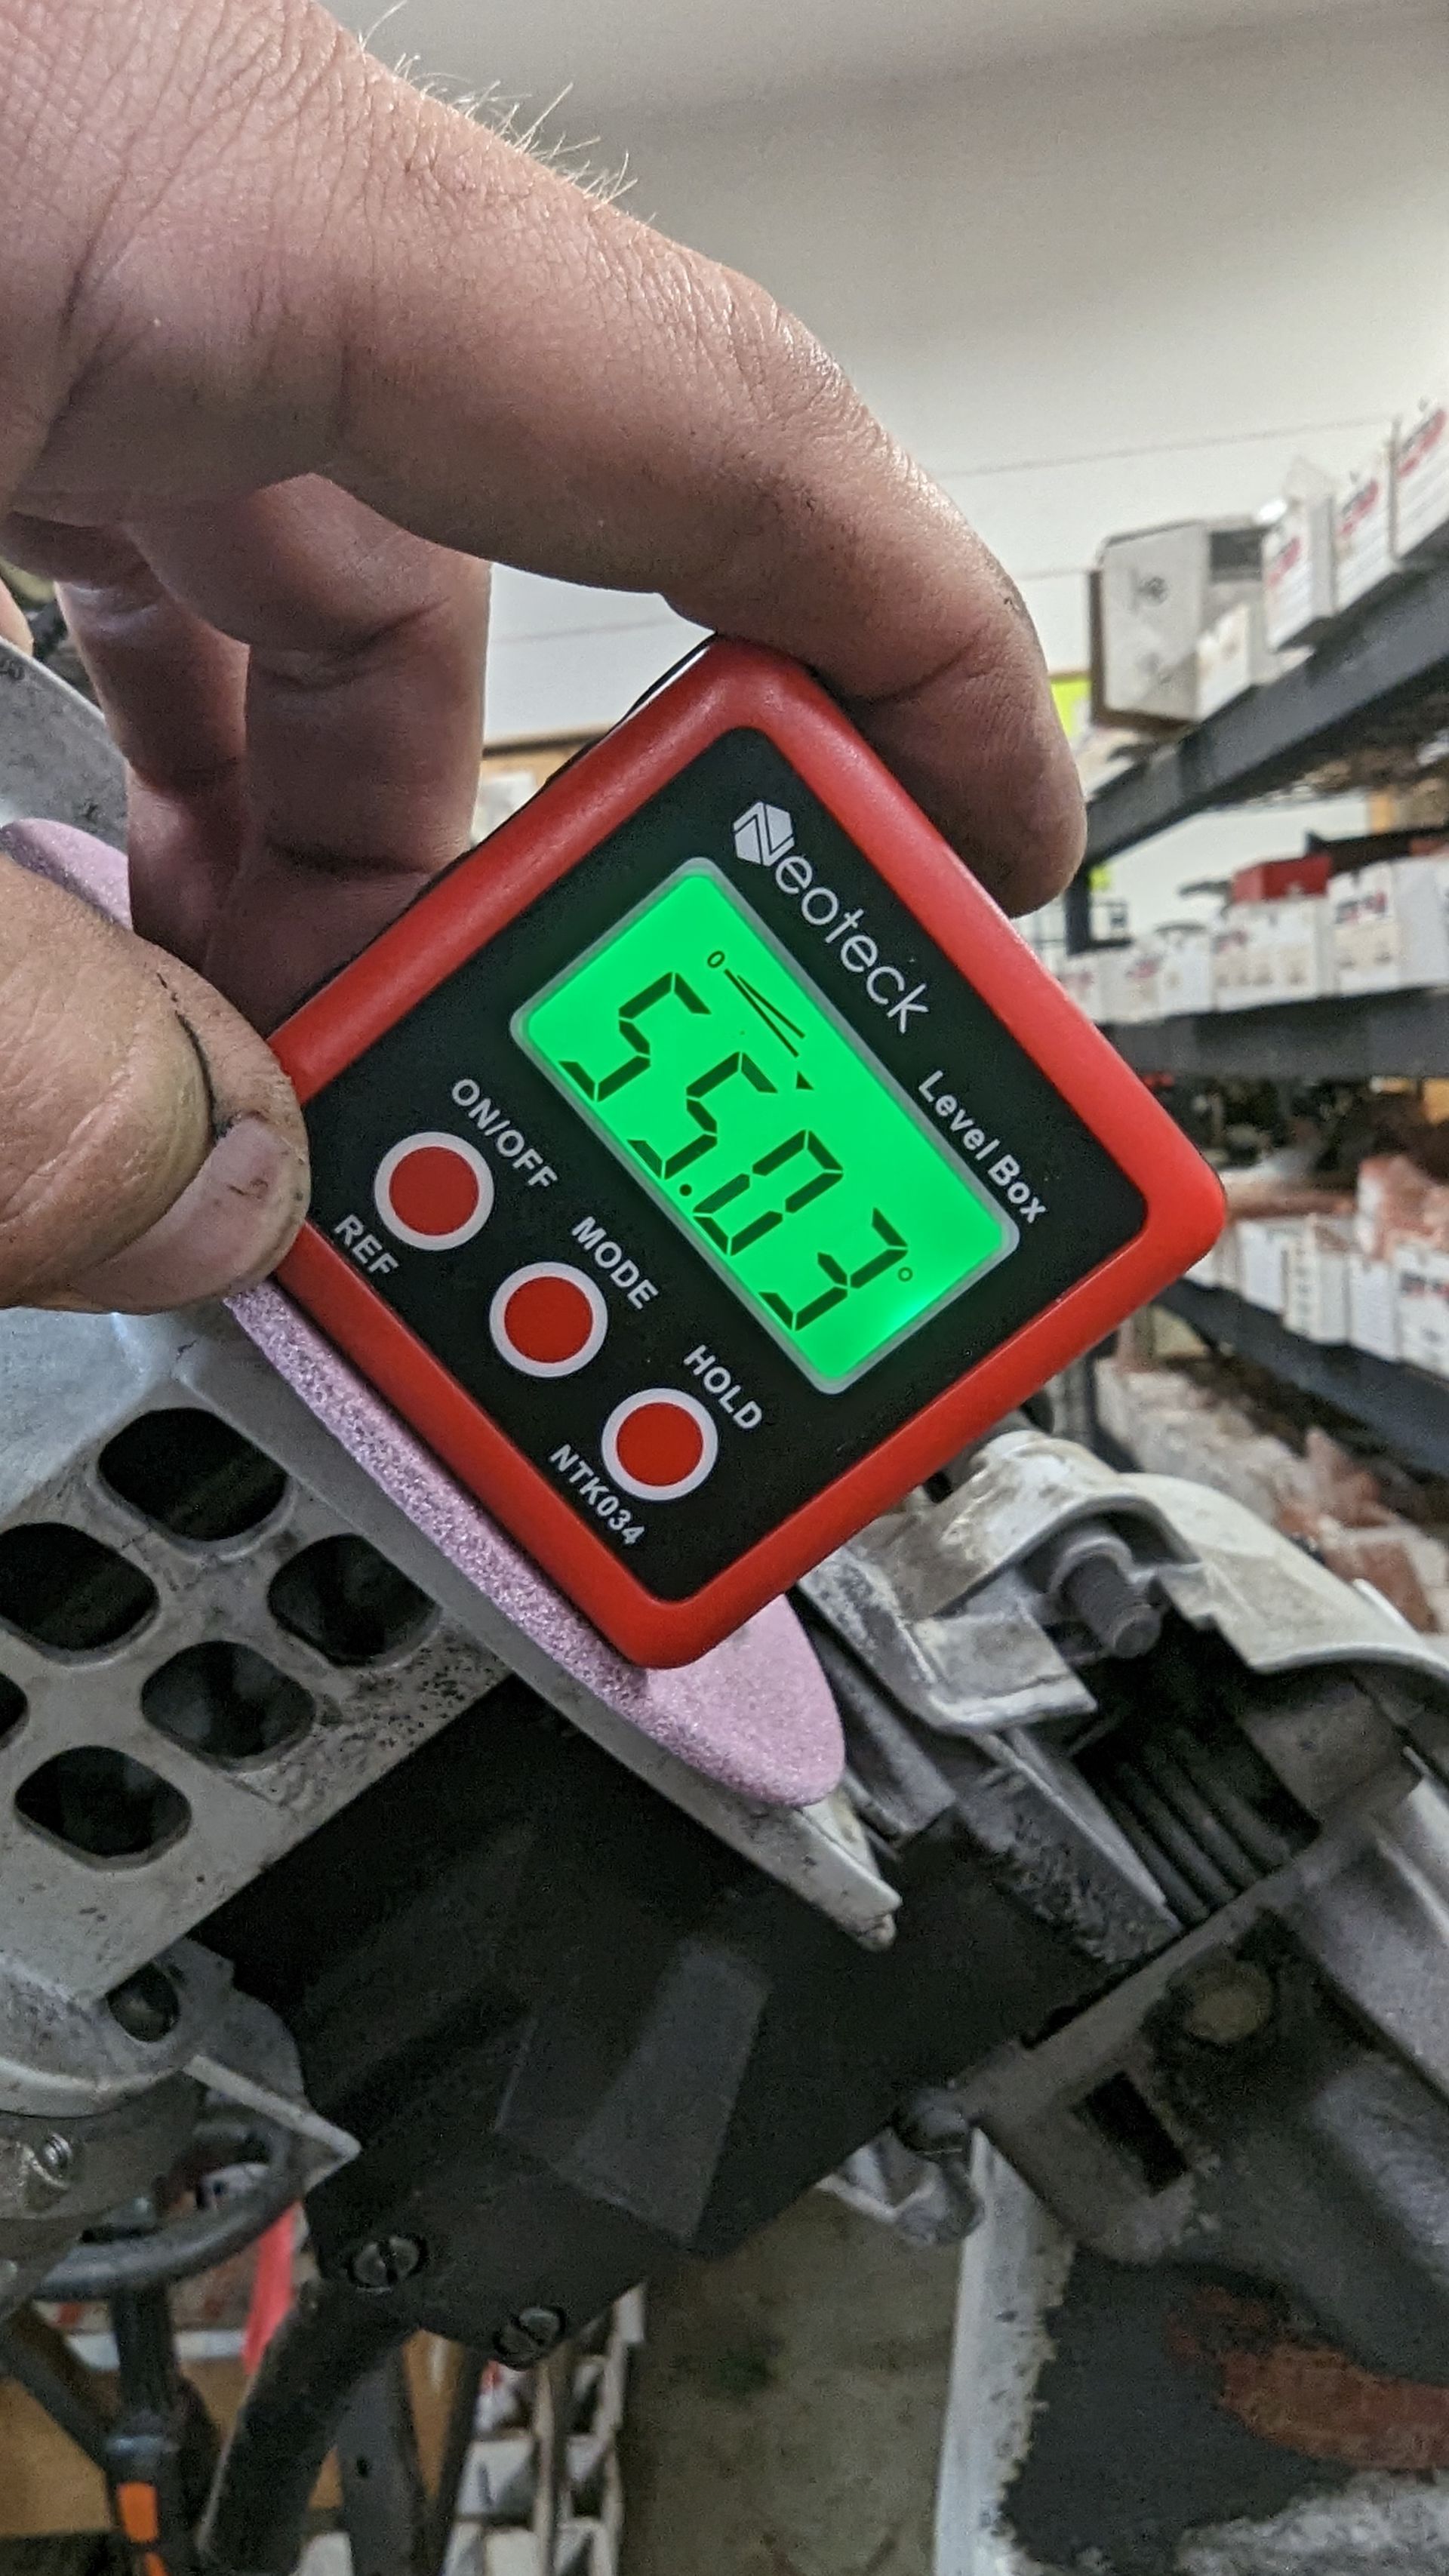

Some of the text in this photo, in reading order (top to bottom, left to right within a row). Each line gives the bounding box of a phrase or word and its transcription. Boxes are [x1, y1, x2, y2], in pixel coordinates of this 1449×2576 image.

[734, 802, 928, 1033] Neoteck
[451, 1078, 558, 1190] ON/OFF
[918, 1070, 1047, 1223] Level Box
[334, 1215, 398, 1276] REF
[571, 1216, 659, 1310] MODE
[684, 1345, 763, 1430] HOLD
[549, 1445, 645, 1546] NTK034
